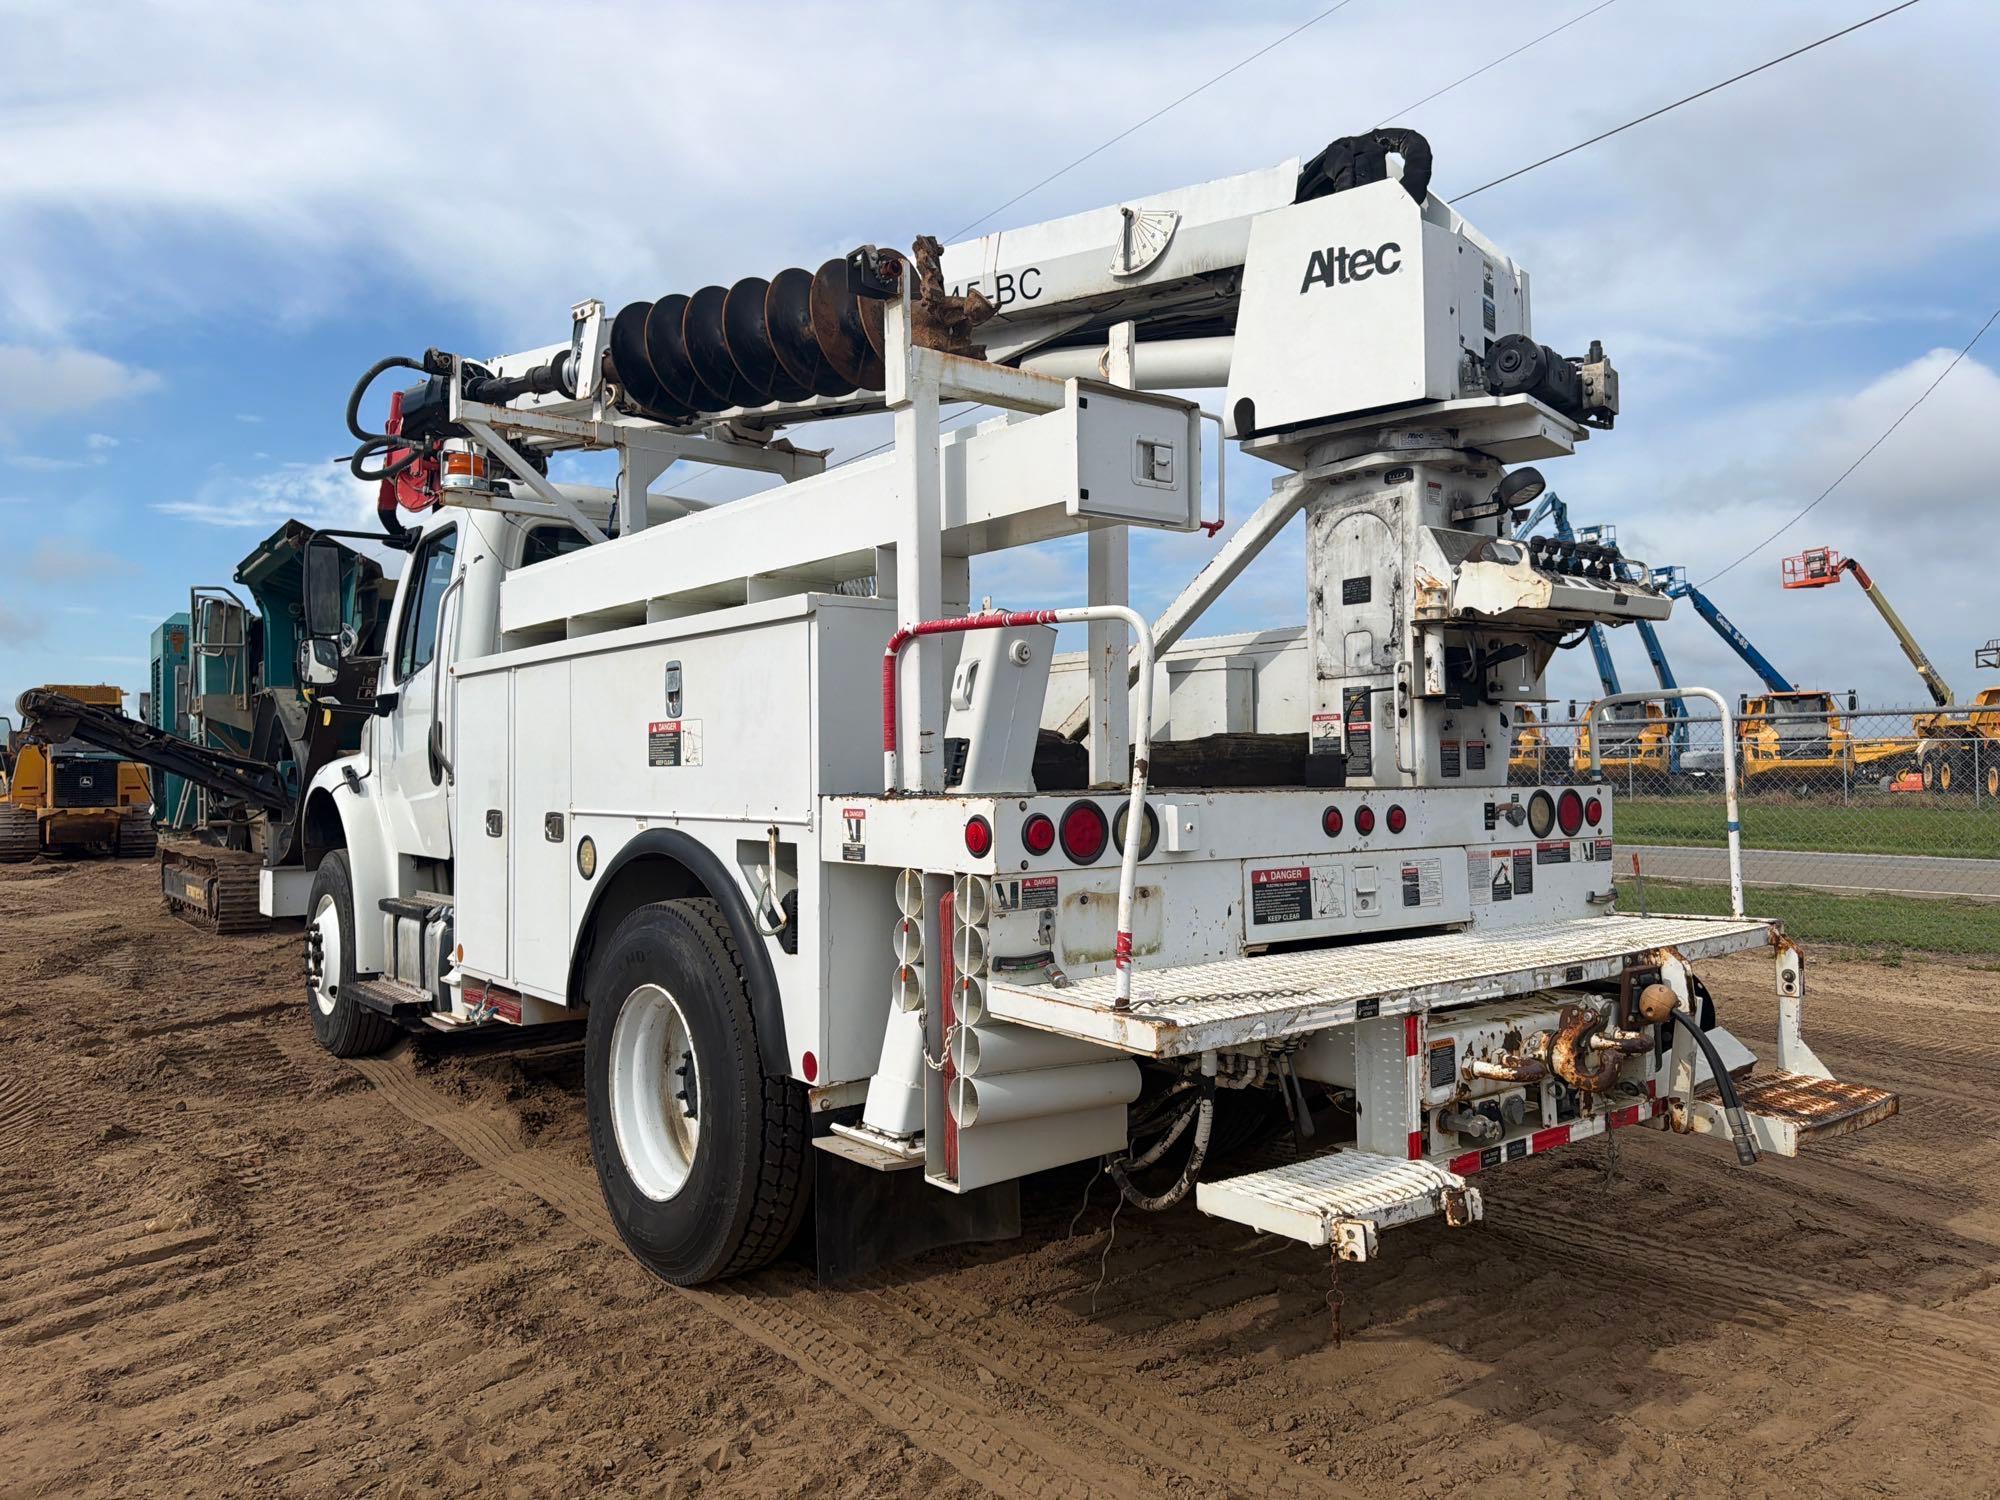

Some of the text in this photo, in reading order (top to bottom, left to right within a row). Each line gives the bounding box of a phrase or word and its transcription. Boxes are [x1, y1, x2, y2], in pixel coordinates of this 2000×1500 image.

[1299, 242, 1401, 295] Altec
[658, 722, 677, 731] DANGER
[1270, 869, 1302, 880] DANGER
[1033, 877, 1056, 887] DANGER
[1267, 912, 1300, 922] KEEP CLEAR
